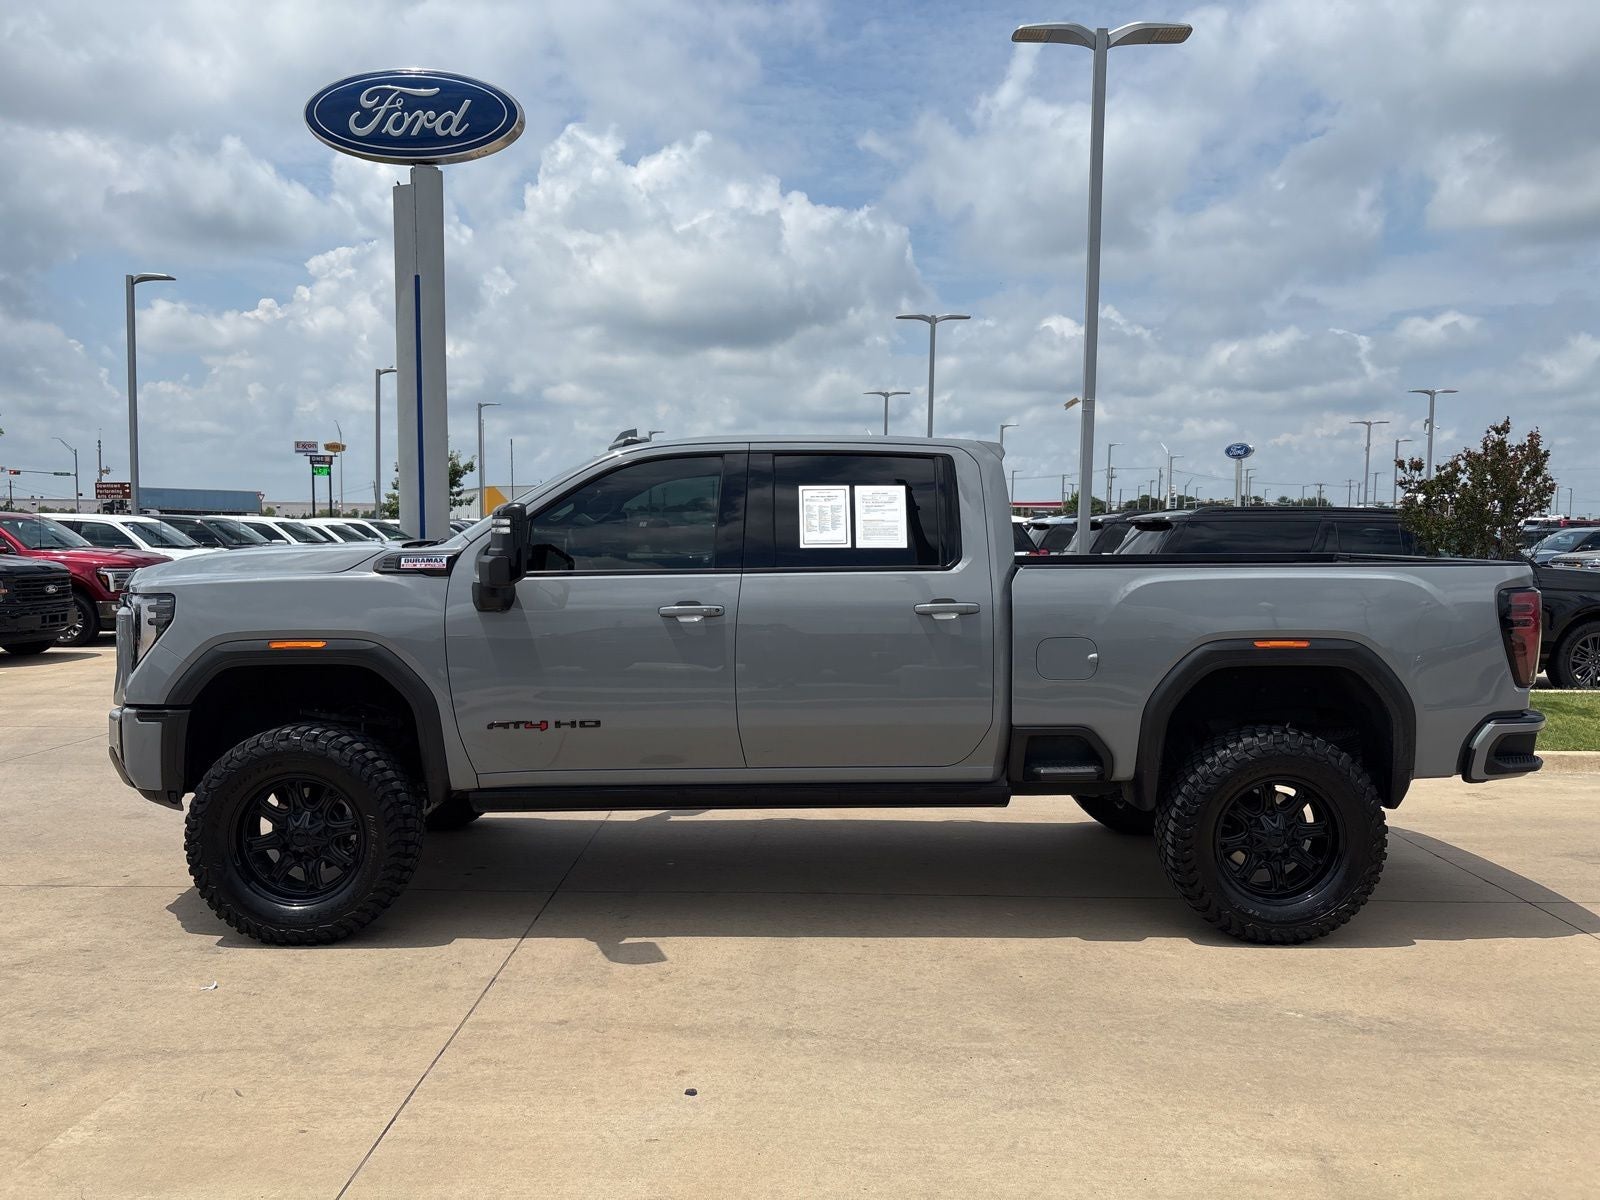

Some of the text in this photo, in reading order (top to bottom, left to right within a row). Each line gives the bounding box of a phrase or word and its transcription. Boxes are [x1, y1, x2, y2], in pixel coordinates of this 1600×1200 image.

[349, 85, 472, 137] Ford
[1229, 445, 1245, 456] Ford
[486, 720, 601, 731] AT4 HD
